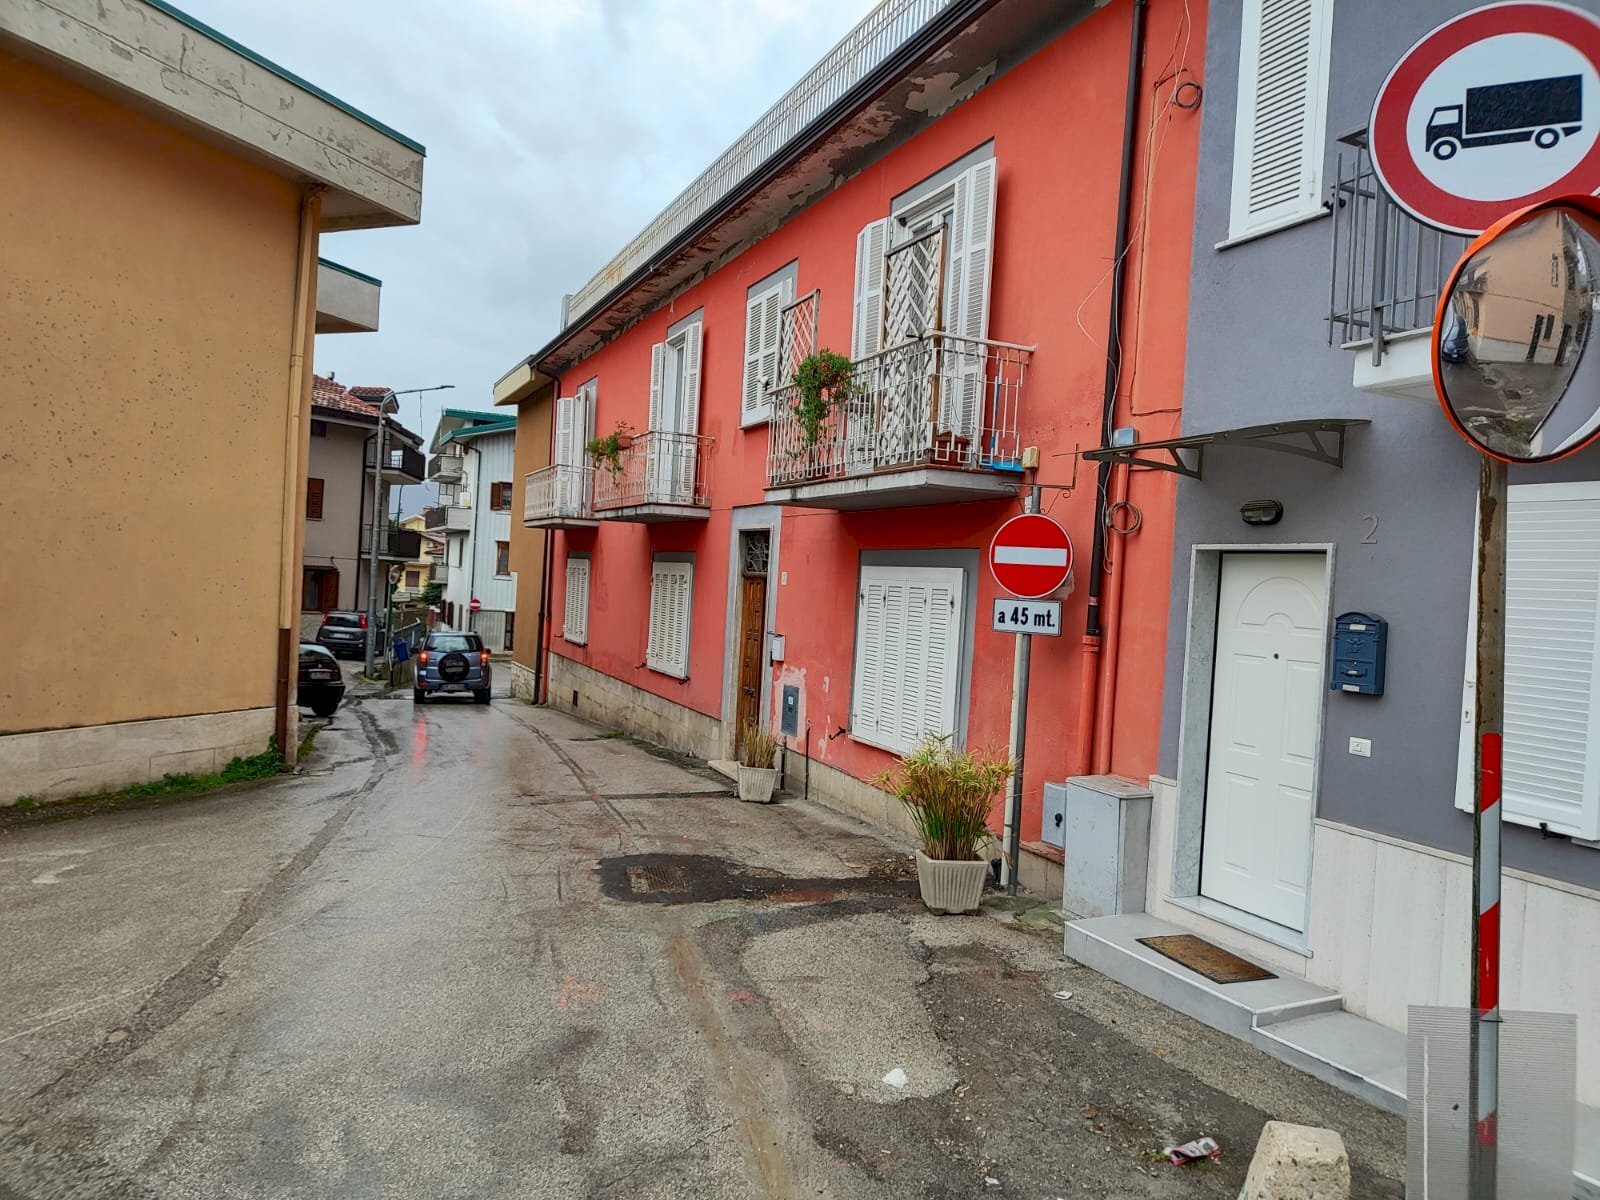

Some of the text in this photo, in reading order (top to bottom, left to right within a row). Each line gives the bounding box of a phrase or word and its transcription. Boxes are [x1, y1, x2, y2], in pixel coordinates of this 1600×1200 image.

[1360, 514, 1379, 545] 2
[998, 606, 1055, 627] a 45 mt.
